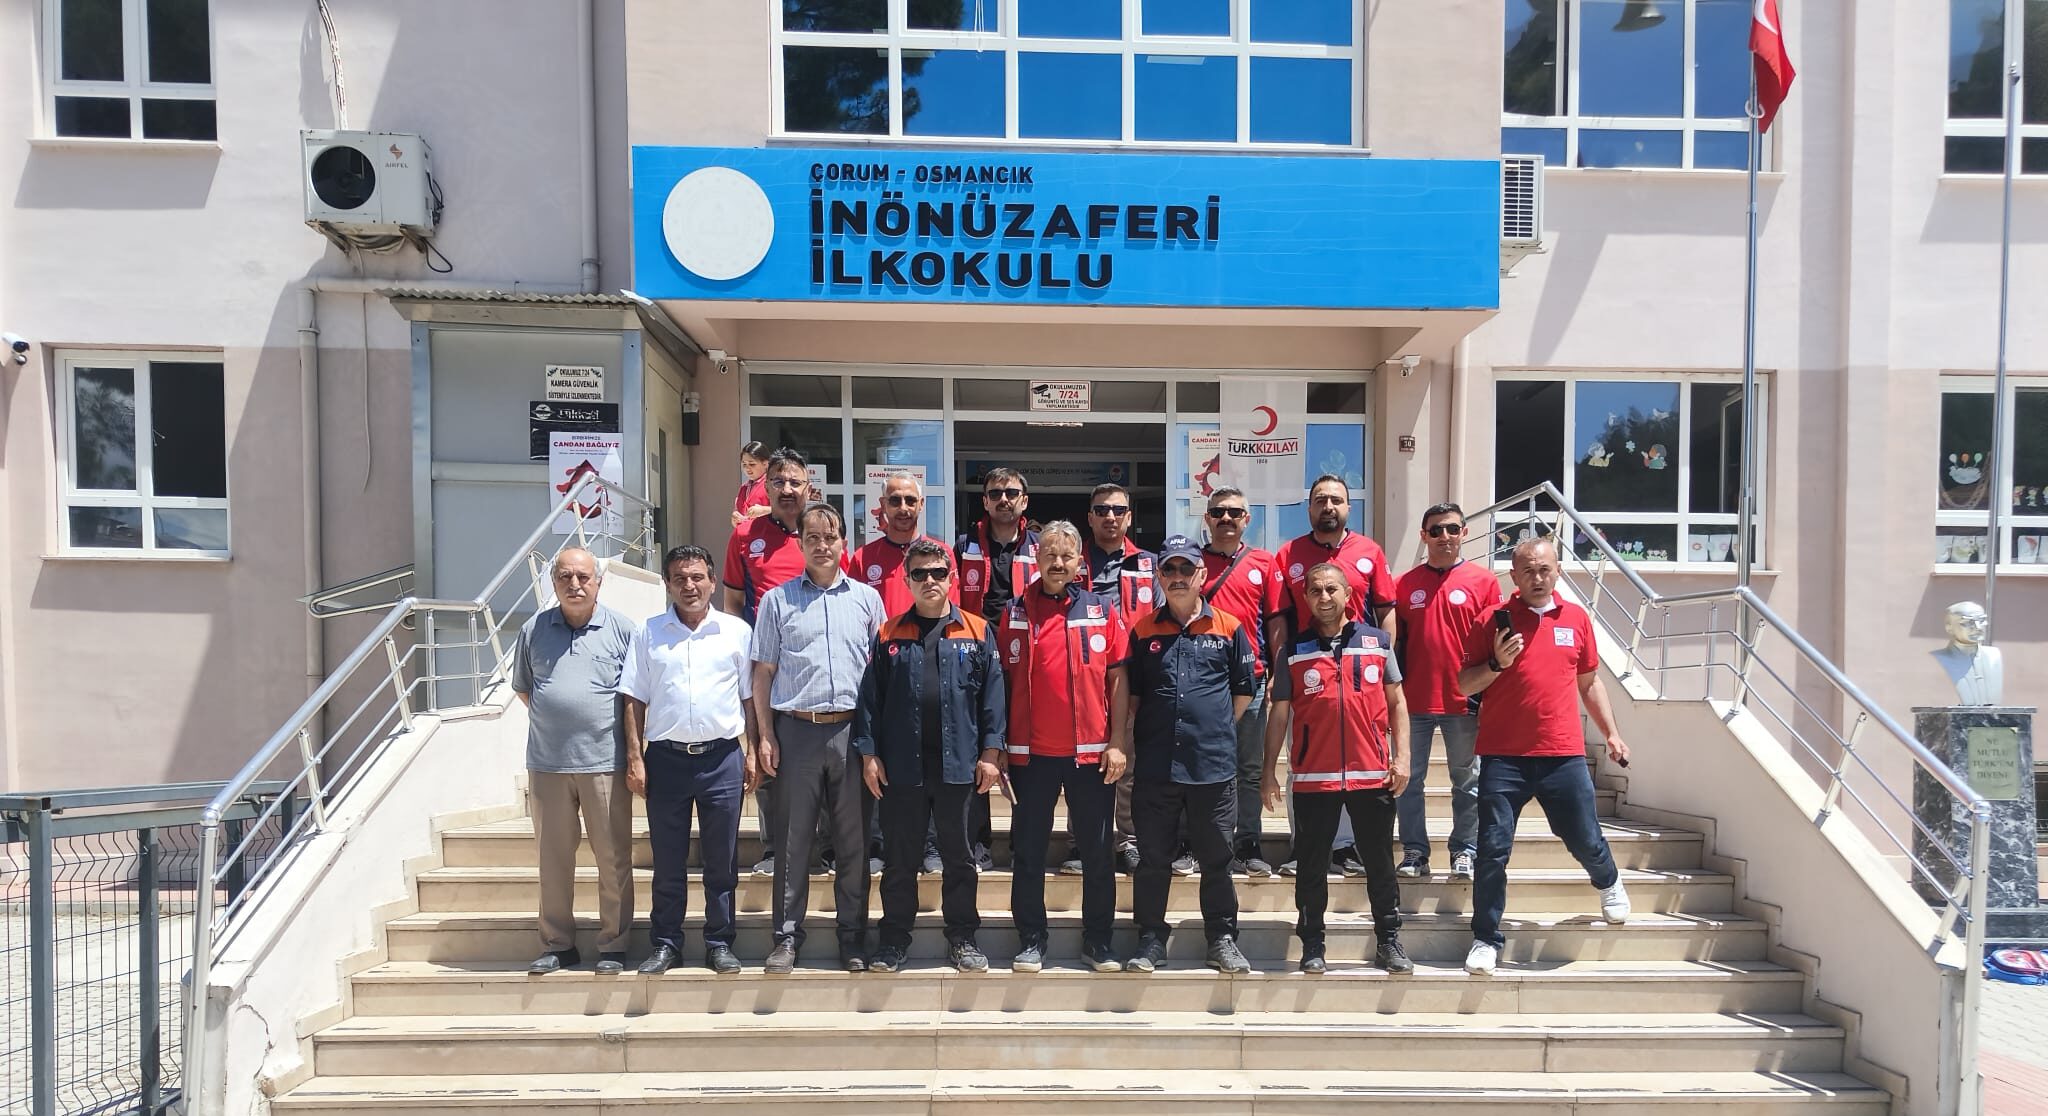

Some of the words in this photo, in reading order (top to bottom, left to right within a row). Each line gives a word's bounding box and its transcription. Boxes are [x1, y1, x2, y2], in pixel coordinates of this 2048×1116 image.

[810, 163, 889, 183] ÇORUM
[914, 165, 1033, 184] OSMANCIK
[811, 188, 1220, 241] İNÖNÜZAFERİ
[811, 239, 1113, 289] İLKOKULU
[551, 380, 572, 388] KAMERA
[573, 380, 598, 388] GÜVENLİK
[1202, 640, 1224, 649] AFAD
